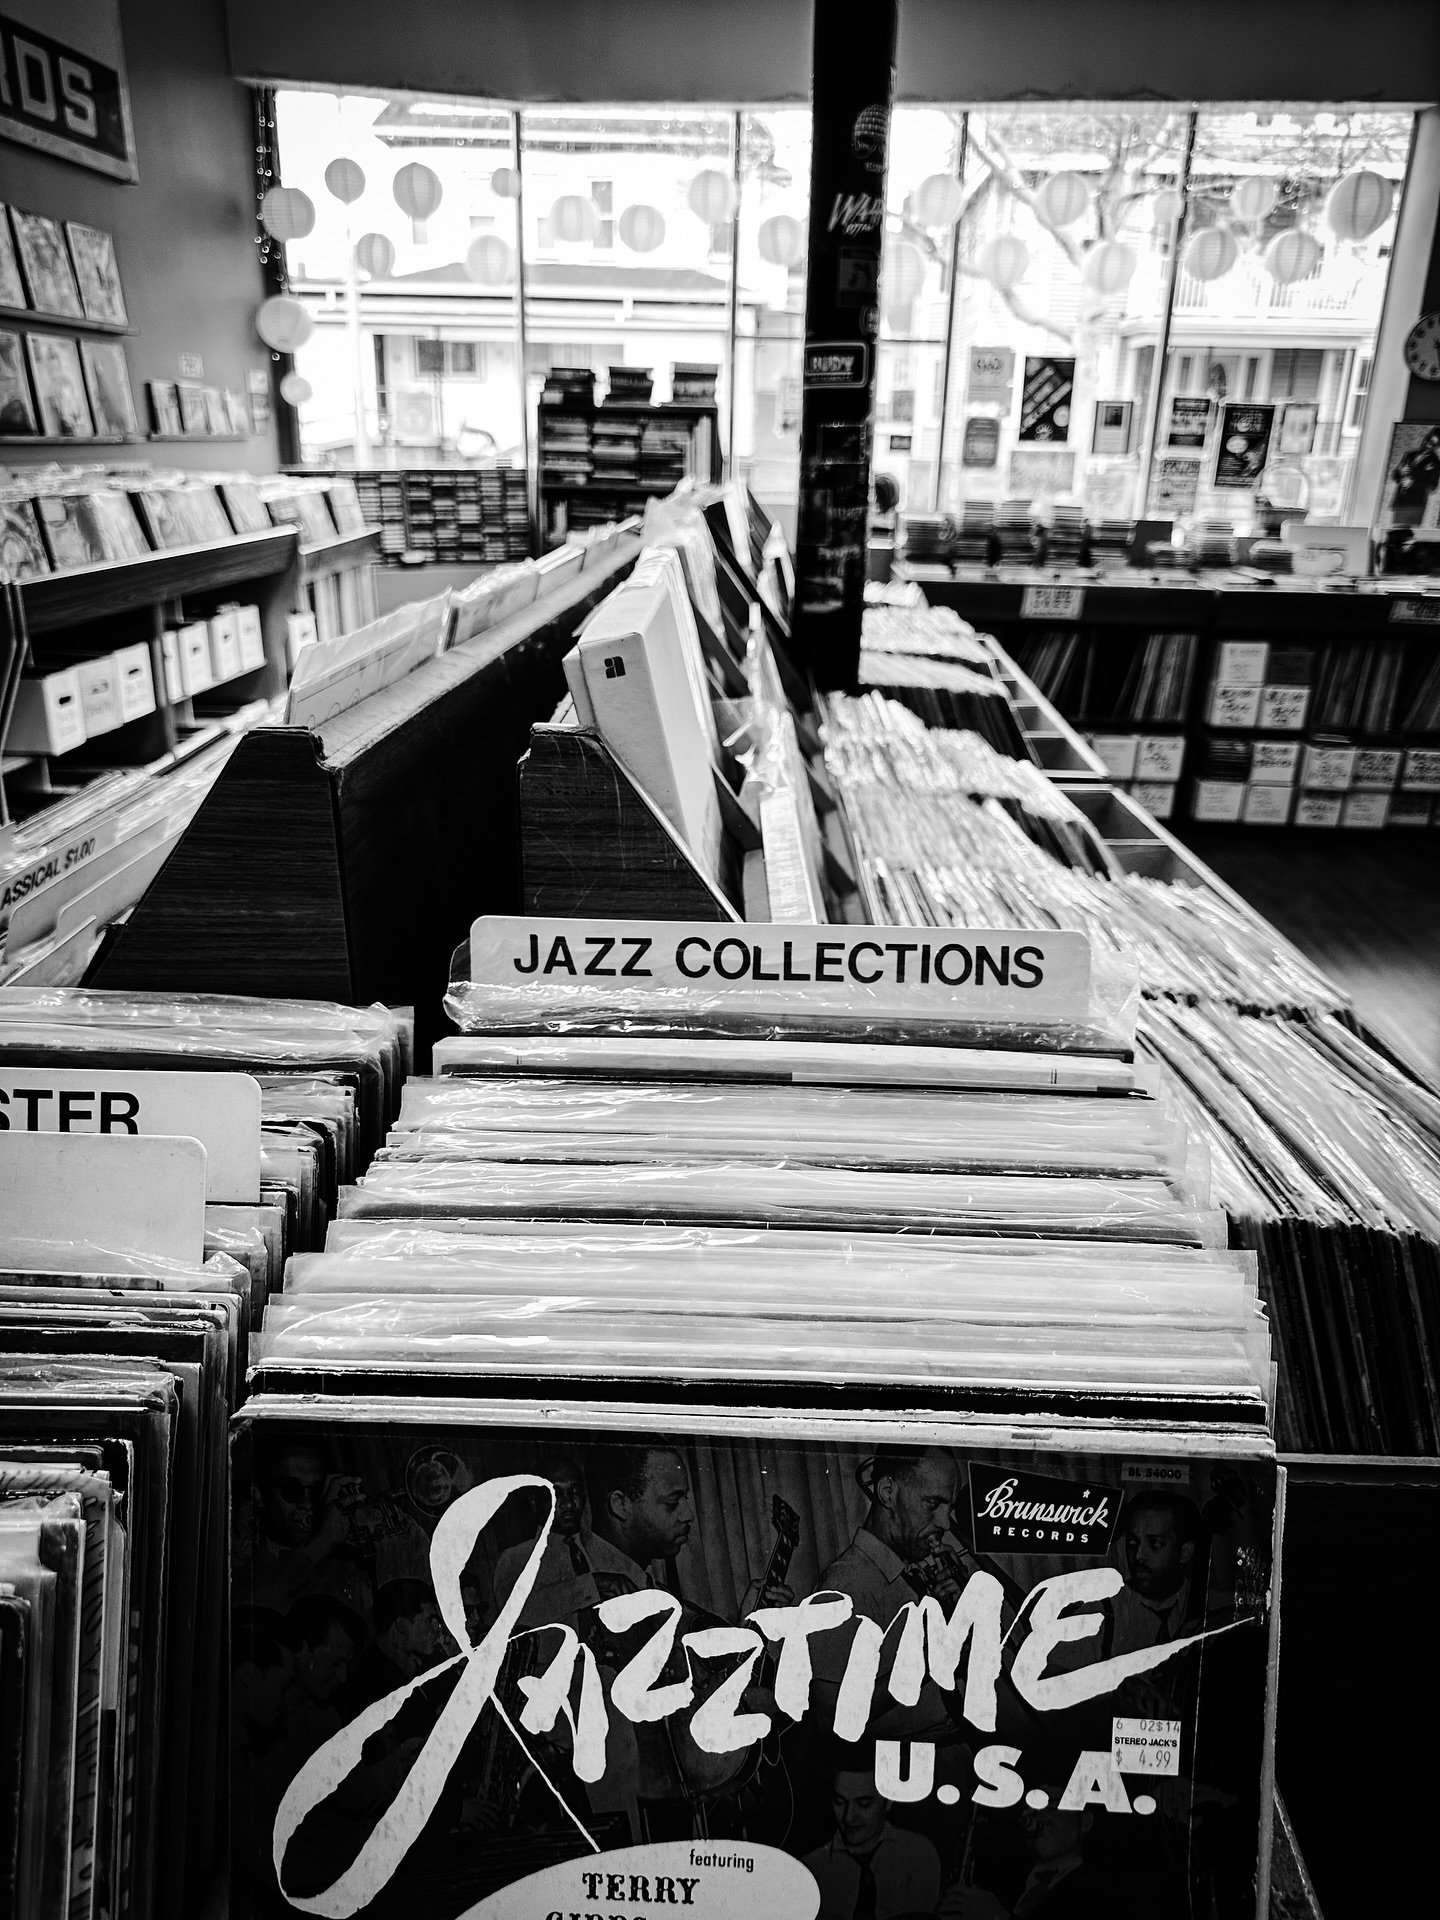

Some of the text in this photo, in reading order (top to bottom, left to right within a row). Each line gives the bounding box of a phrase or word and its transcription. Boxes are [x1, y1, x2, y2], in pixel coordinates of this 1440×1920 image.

[0, 26, 99, 139] DS
[513, 933, 1045, 989] JAZZ COLLECTIONS
[0, 1088, 140, 1135] TER
[977, 1478, 1109, 1528] Brunswick
[993, 1525, 1089, 1543] RECORDS
[1114, 1736, 1178, 1748] STEREO JACK'S
[1139, 1749, 1171, 1769] 4.99
[874, 1739, 1157, 1815] U.S.A.
[689, 1848, 754, 1873] featuring
[581, 1872, 701, 1905] TERRY
